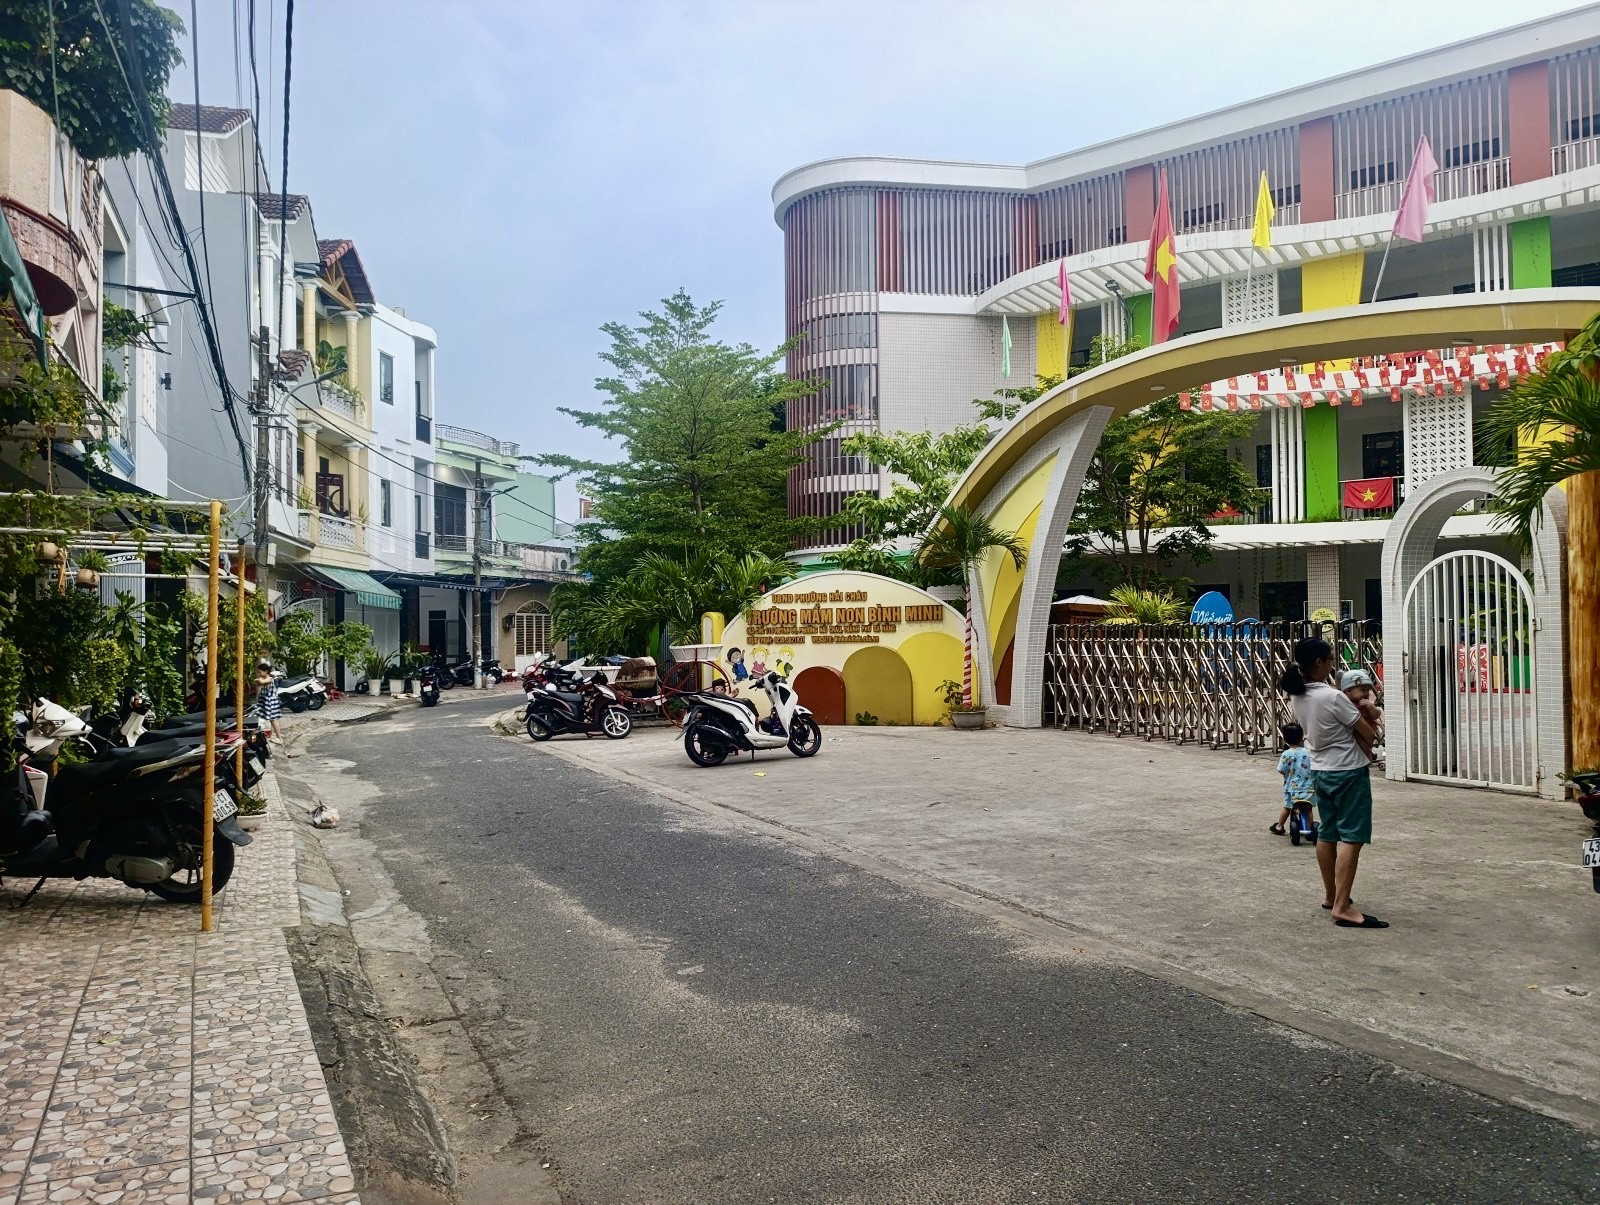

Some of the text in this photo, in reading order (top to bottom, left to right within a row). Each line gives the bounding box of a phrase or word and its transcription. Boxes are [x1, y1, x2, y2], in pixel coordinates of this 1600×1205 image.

[772, 594, 793, 603] UBND
[836, 607, 865, 623] NON
[868, 604, 901, 623] BÌNH
[905, 605, 943, 622] MINH
[1585, 853, 1600, 866] 04
